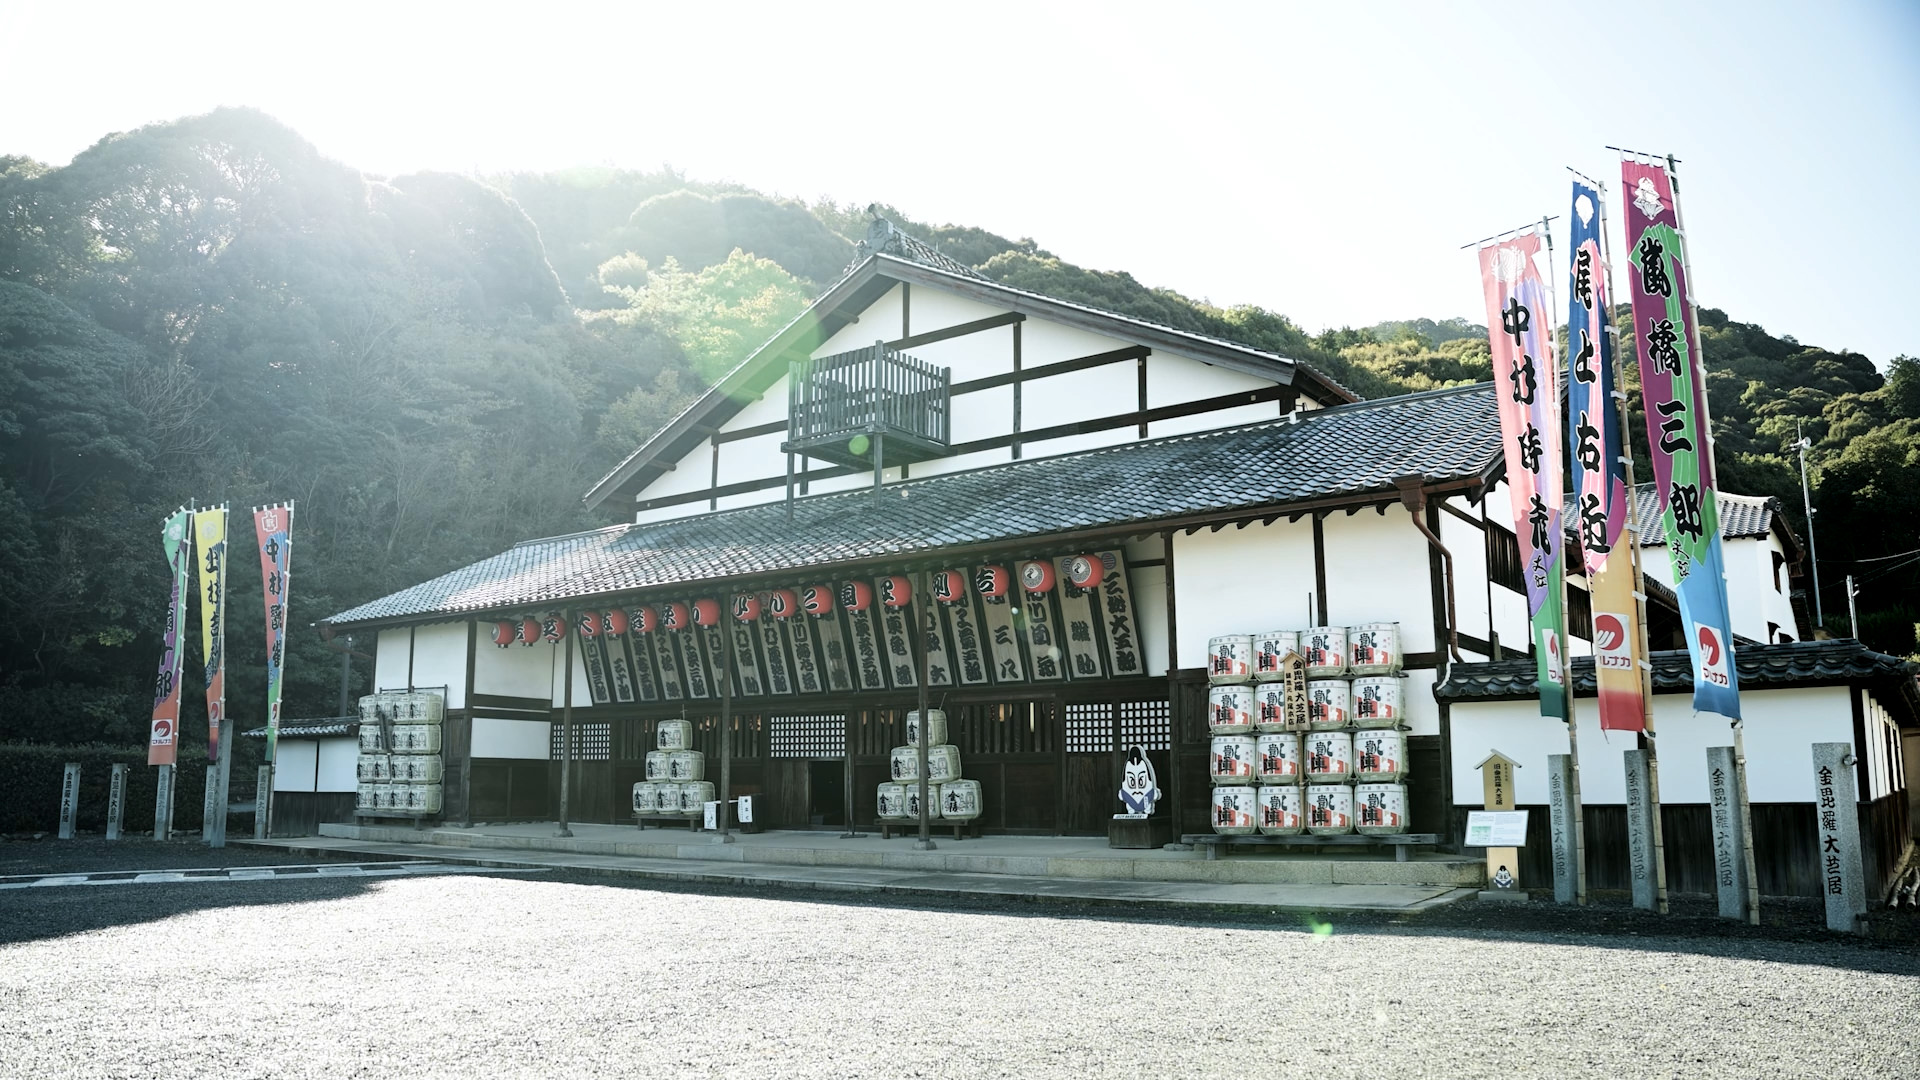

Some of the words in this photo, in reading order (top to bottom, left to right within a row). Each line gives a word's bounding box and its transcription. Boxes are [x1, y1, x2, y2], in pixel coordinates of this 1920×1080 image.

[1599, 655, 1631, 668] ルナカ
[1818, 765, 1843, 896] 金毘羅大芝居
